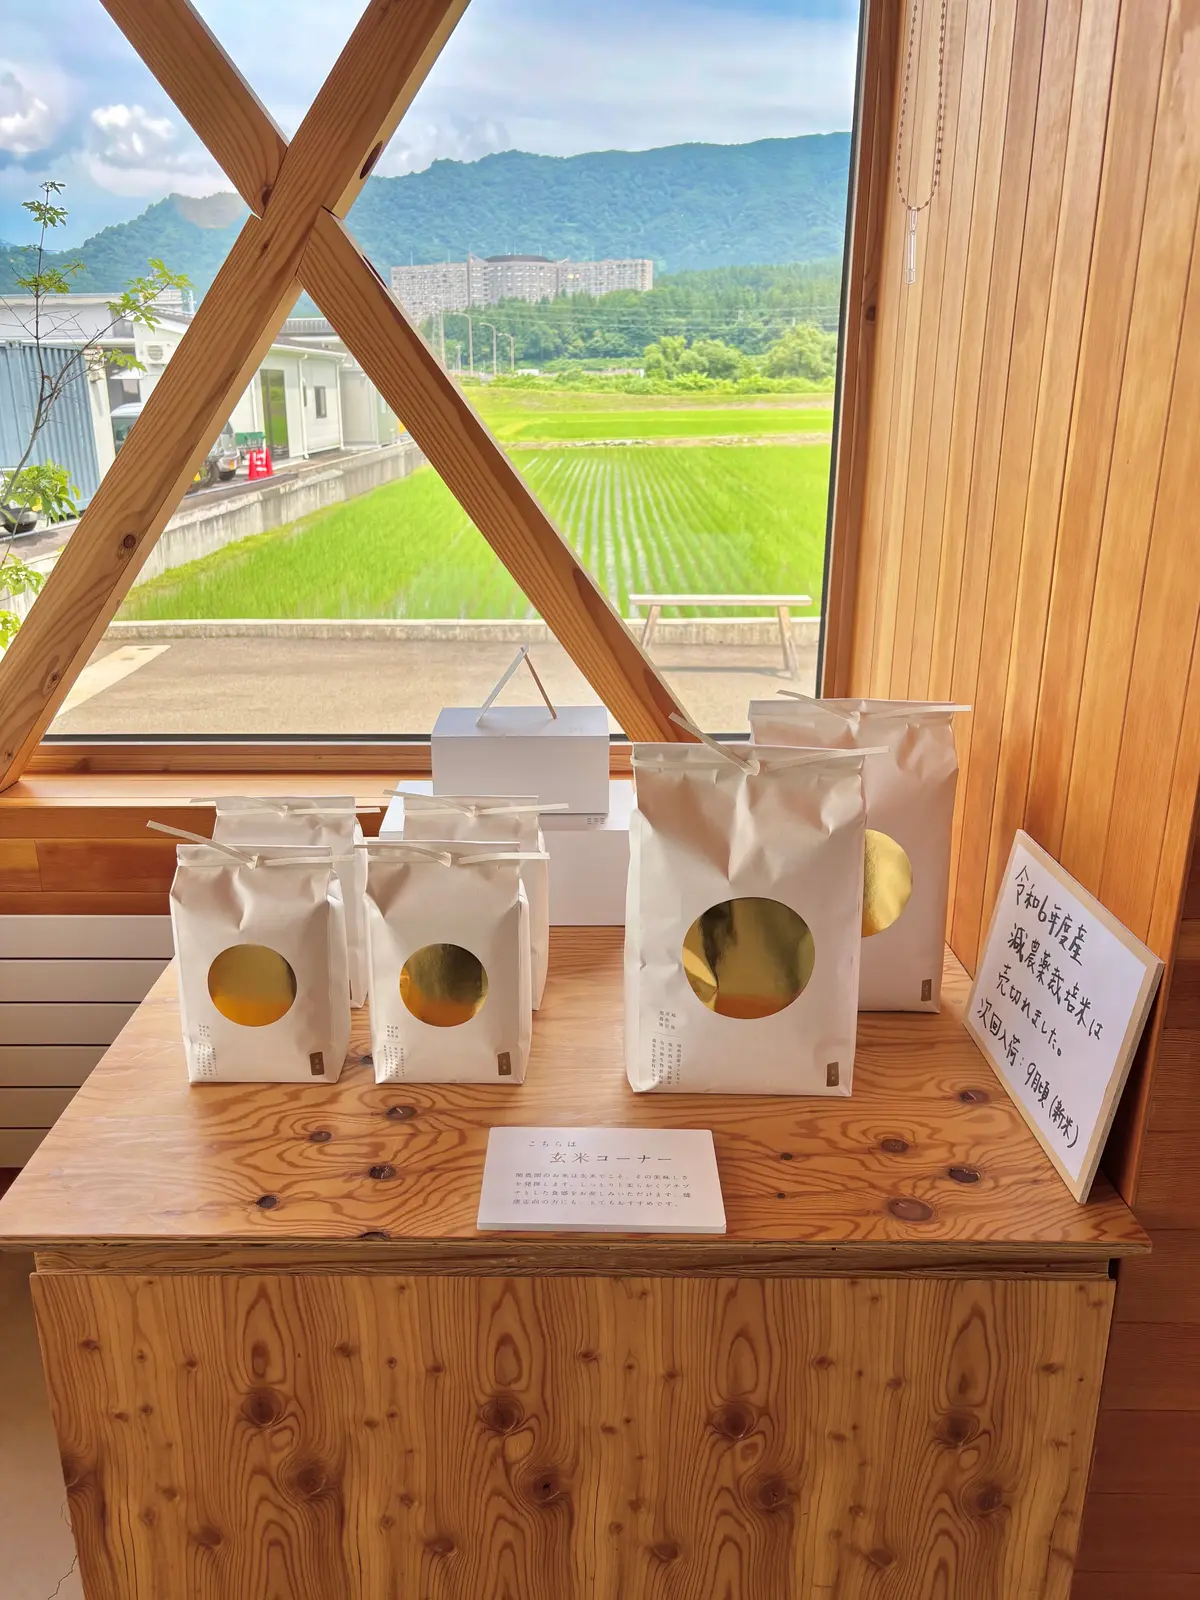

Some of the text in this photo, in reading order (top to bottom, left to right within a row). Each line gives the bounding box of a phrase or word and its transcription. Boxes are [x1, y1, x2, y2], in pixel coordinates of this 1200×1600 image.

[1014, 865, 1089, 966] 令和6年度産
[995, 963, 1063, 1057] 売切れました。
[1007, 922, 1104, 1040] 減農薬栽培米は
[549, 1152, 672, 1164] 玄米コーナー
